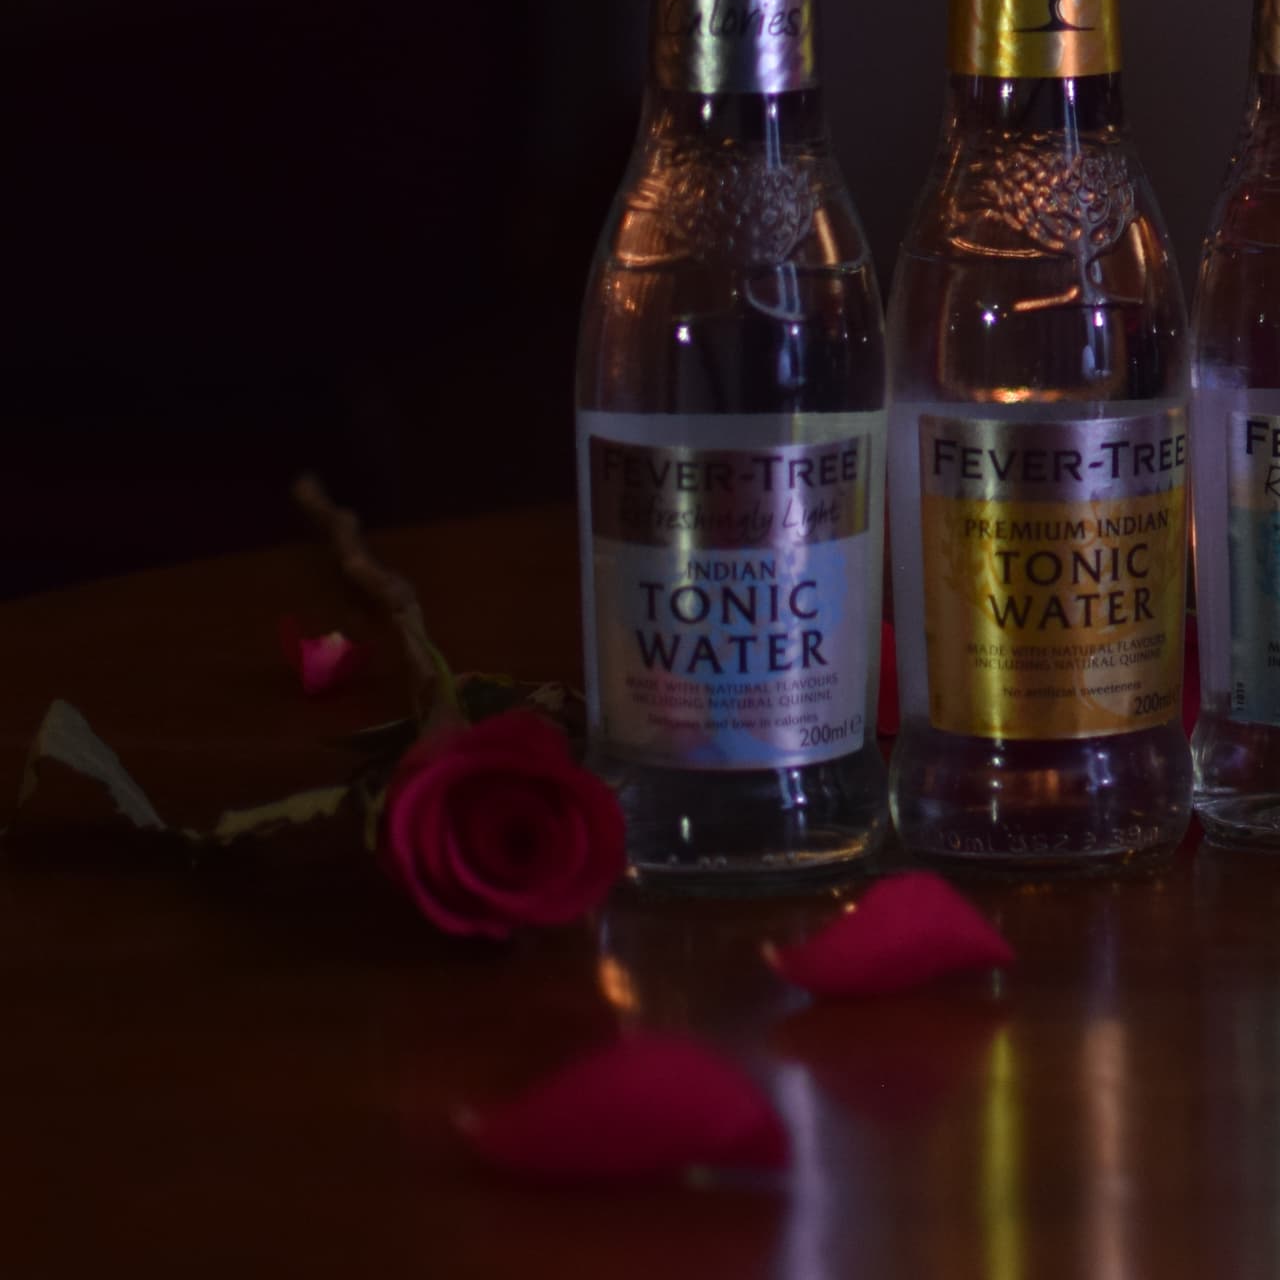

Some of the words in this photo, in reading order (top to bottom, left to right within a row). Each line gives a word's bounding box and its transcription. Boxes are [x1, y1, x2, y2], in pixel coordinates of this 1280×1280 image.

[603, 447, 859, 491] FEVER-TREE
[933, 434, 1186, 482] FEVER-TREE
[964, 518, 1086, 541] PREMIUM
[1097, 508, 1170, 538] INDIAN
[686, 559, 777, 581] INDIAN
[995, 543, 1150, 587] TONIC
[639, 581, 819, 624] TONIC
[988, 587, 1156, 631] WATER
[636, 629, 828, 674] WATER
[775, 673, 839, 694] FLAVOURS
